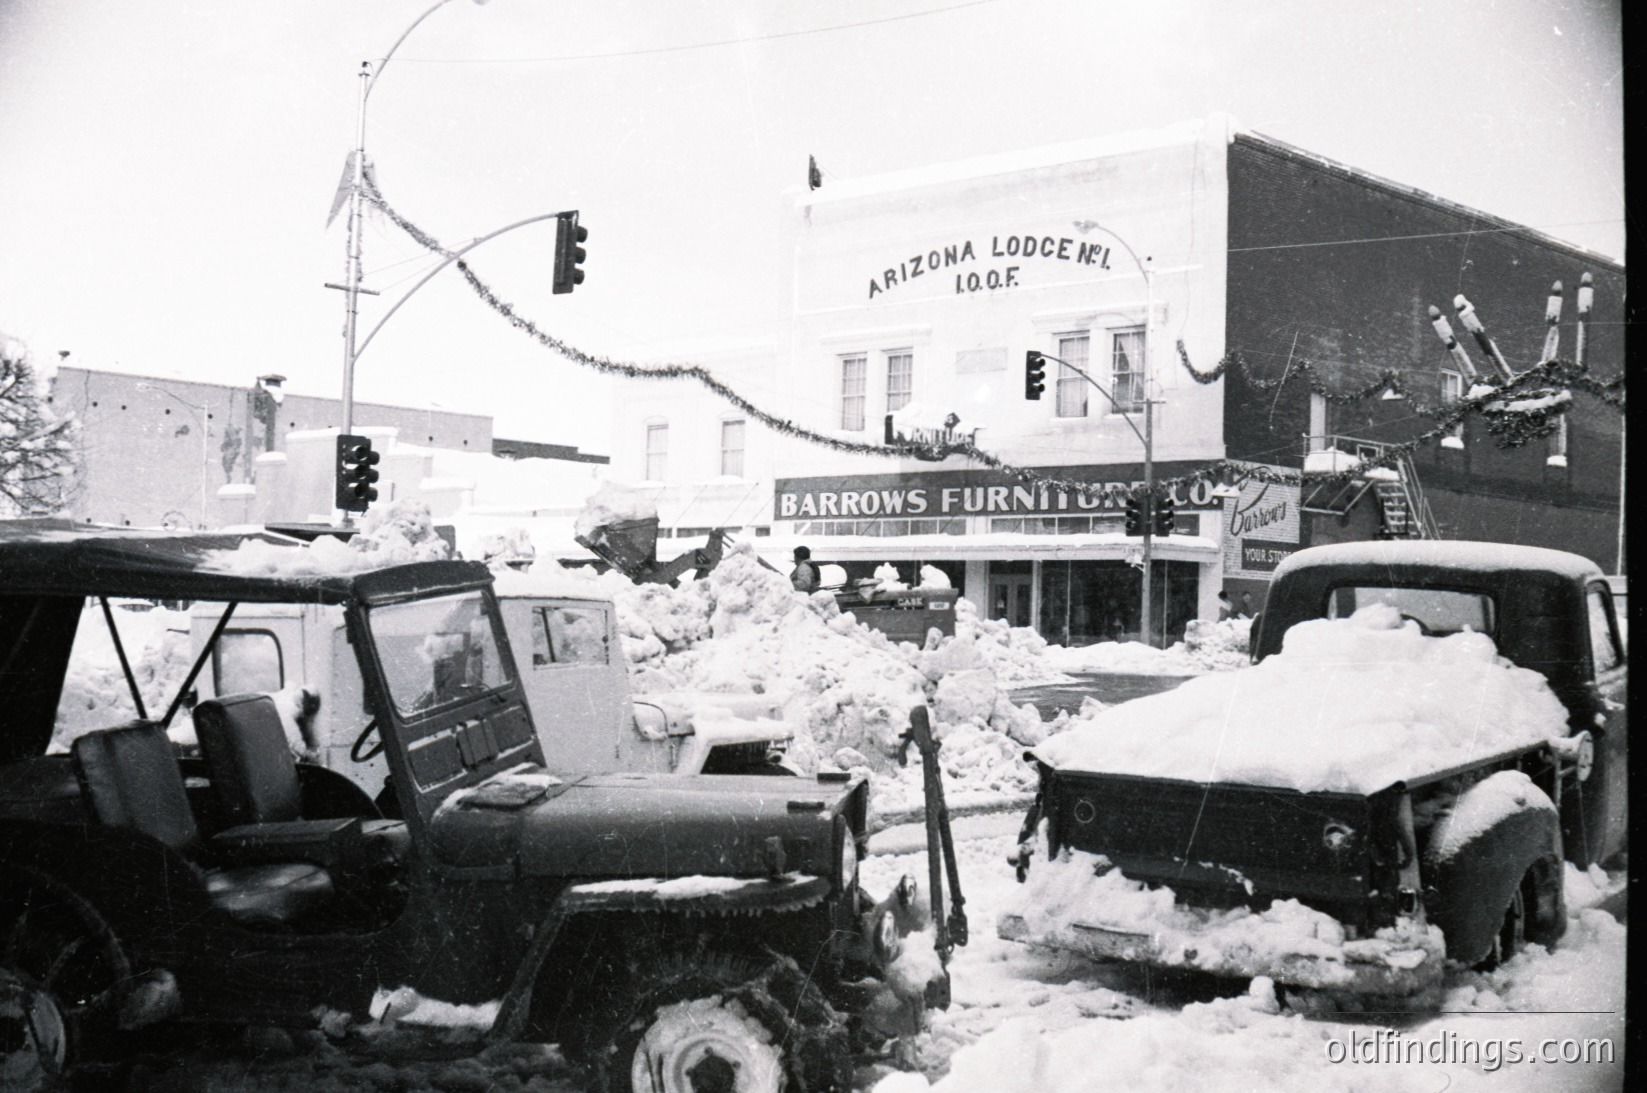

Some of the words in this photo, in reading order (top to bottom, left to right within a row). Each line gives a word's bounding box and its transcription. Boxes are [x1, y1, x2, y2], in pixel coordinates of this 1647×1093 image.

[868, 240, 976, 299] ARIZONA
[780, 489, 928, 517] BARROWS
[1245, 548, 1267, 562] YOUR
